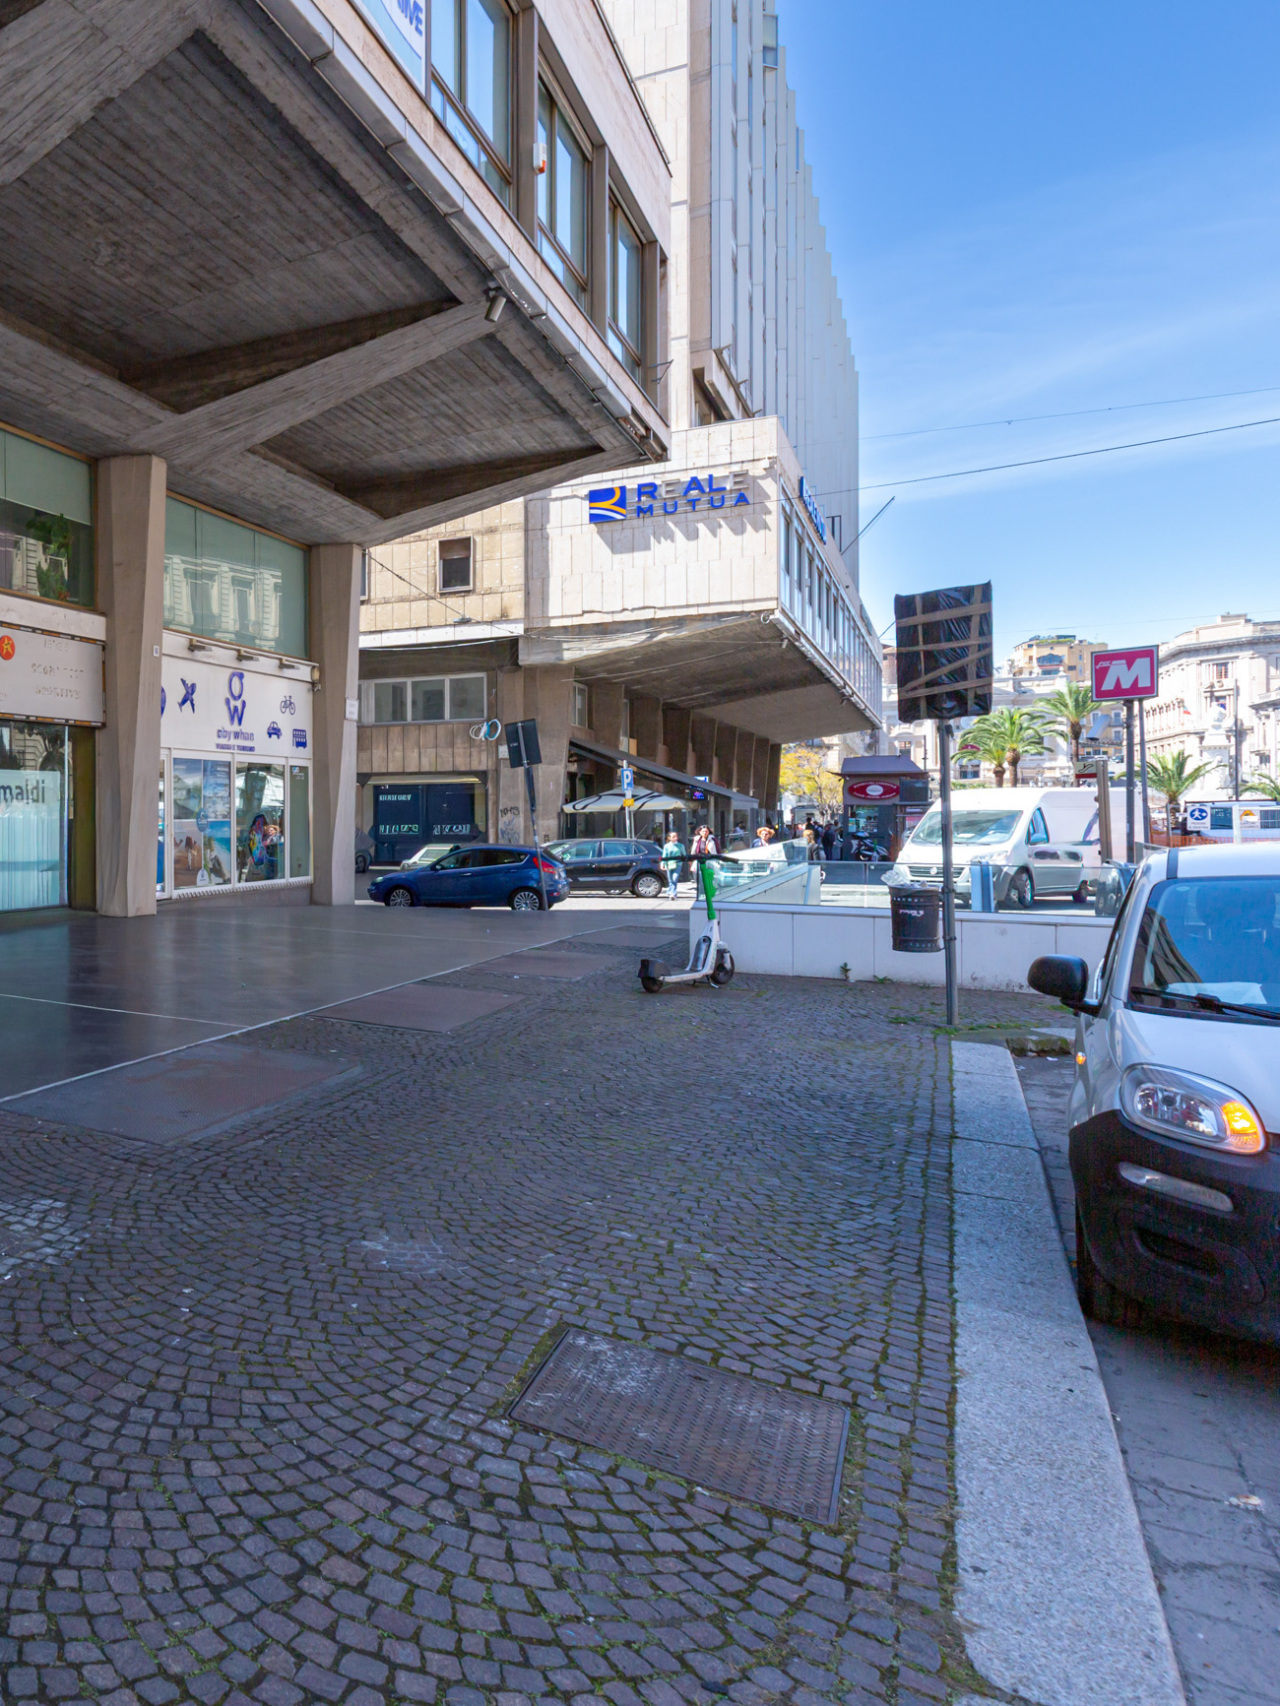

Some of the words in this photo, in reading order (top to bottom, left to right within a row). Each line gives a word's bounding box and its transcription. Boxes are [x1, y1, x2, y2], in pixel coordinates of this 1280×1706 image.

[636, 468, 750, 502] REALE
[636, 491, 750, 518] MUTUA
[1101, 657, 1151, 691] M
[623, 770, 632, 789] P
